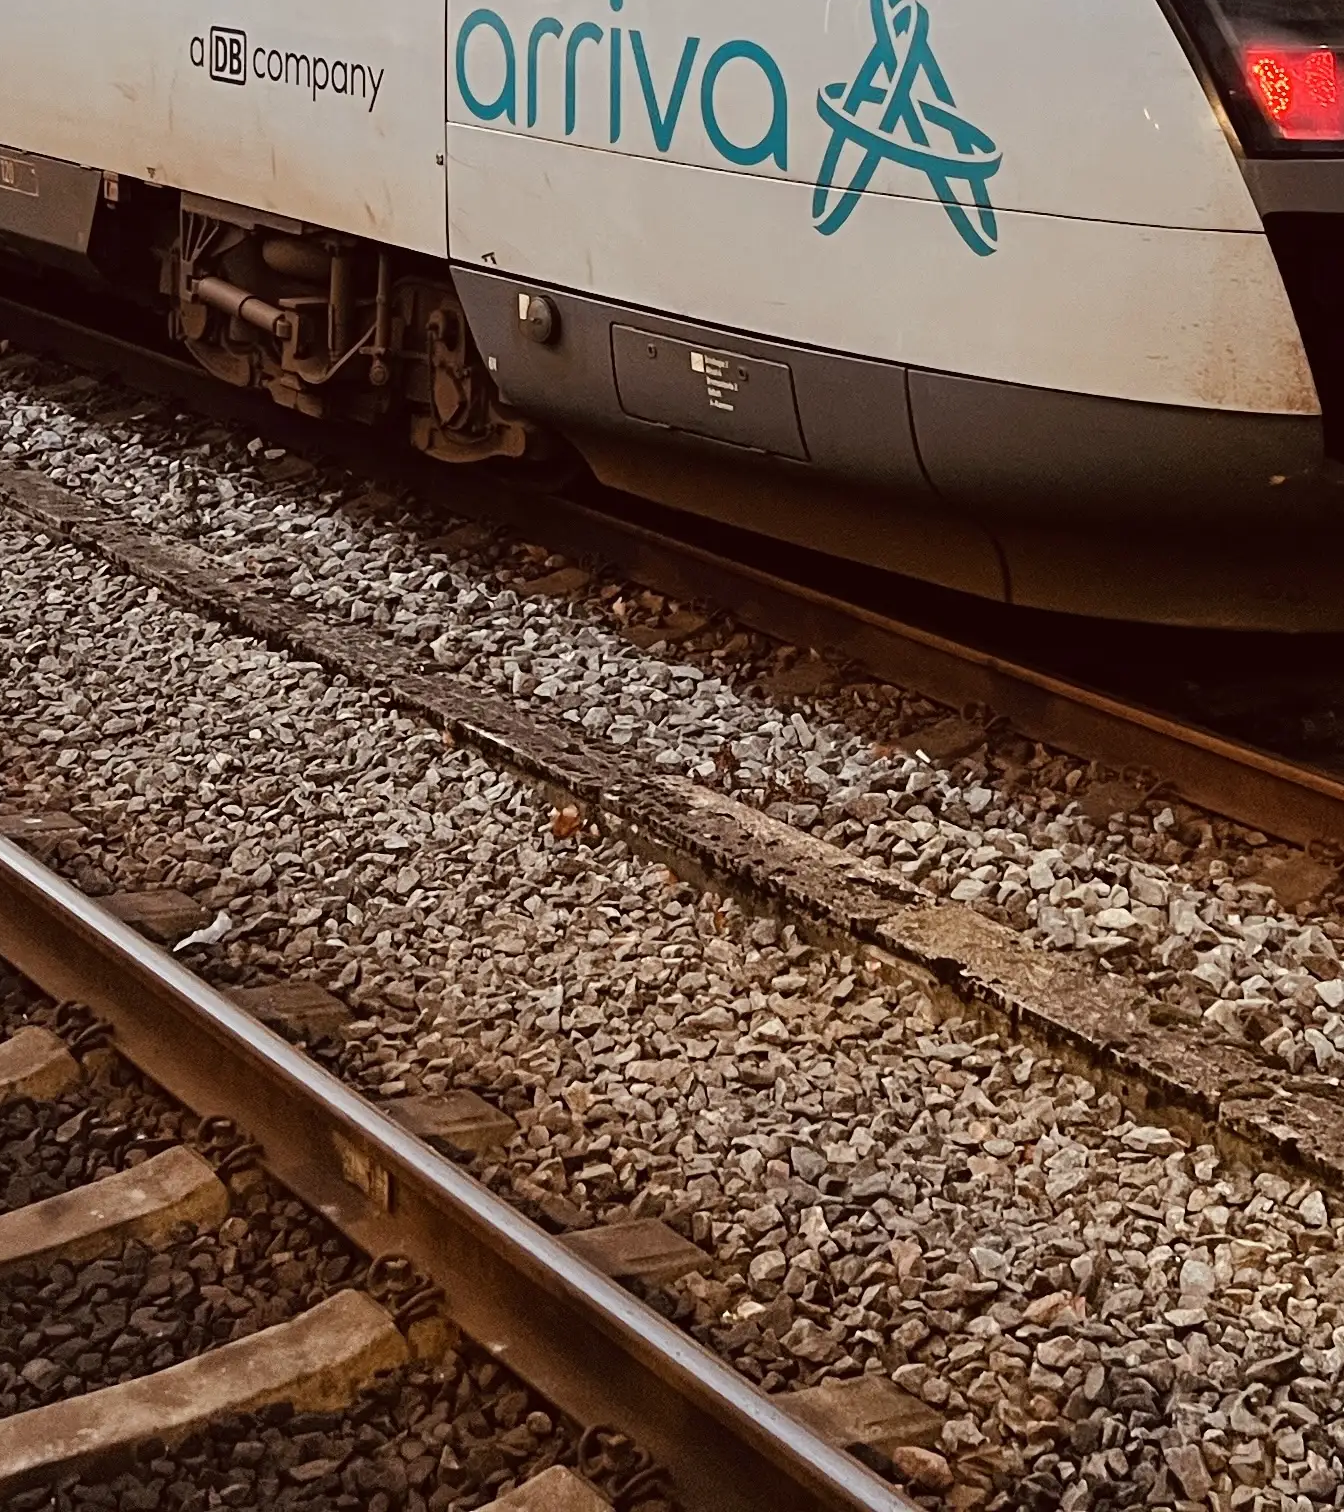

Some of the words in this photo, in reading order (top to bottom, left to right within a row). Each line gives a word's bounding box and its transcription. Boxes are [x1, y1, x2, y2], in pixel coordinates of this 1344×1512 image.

[190, 36, 204, 67] a
[214, 34, 243, 76] DB
[253, 47, 385, 113] company
